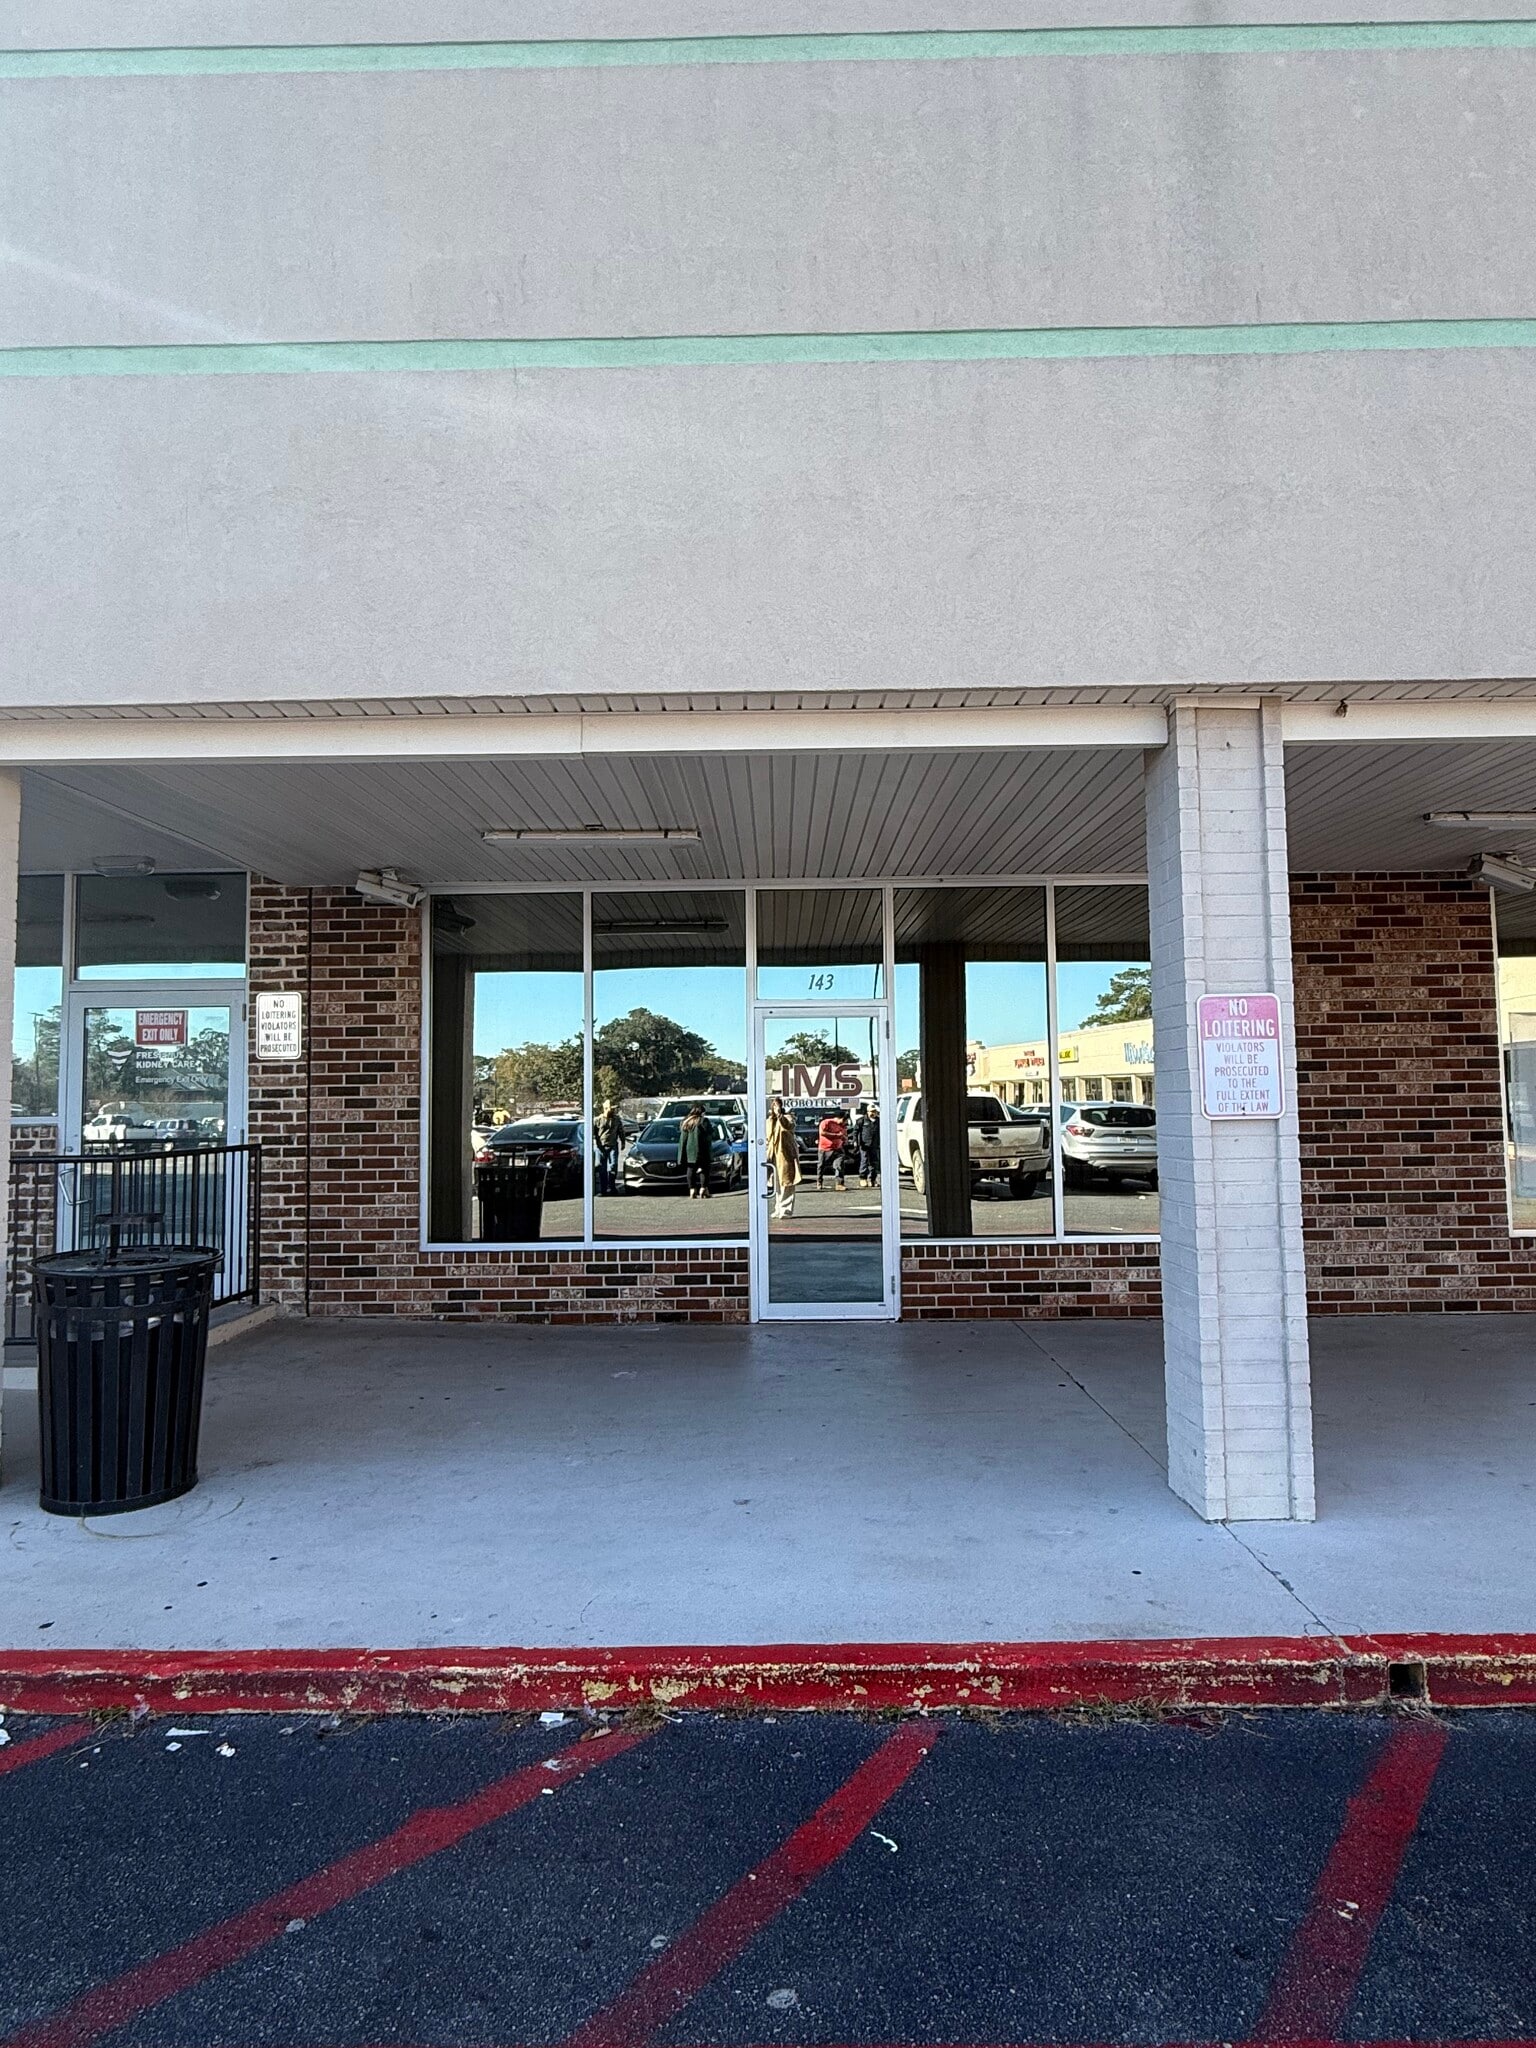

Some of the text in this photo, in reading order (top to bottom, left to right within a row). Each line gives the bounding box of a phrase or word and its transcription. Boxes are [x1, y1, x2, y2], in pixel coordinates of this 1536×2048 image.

[808, 973, 835, 990] 143
[273, 999, 285, 1008] NO
[1228, 998, 1248, 1016] NO
[138, 1012, 183, 1026] EMERGENCY
[261, 1010, 297, 1020] LOITERING
[260, 1021, 297, 1031] VIOLATORS
[1204, 1019, 1275, 1037] LOITERING
[142, 1028, 179, 1041] EXIT ONLY
[265, 1032, 293, 1042] WILL BE
[260, 1043, 297, 1053] PROSECUTED
[1216, 1042, 1265, 1053] VIOLATORS
[136, 1051, 185, 1060] FRESENIUS
[1223, 1054, 1259, 1065] WILL BE
[136, 1060, 195, 1069] KIDNEY CARE
[1215, 1066, 1269, 1077] PROSECUTED
[135, 1075, 174, 1085] Emergency
[781, 1063, 863, 1098] IMS
[1228, 1078, 1257, 1088] TO THE
[1216, 1090, 1270, 1101] FULL EXTENT
[783, 1098, 838, 1108] ROBOTICS
[1218, 1102, 1268, 1112] OF THE LAW
